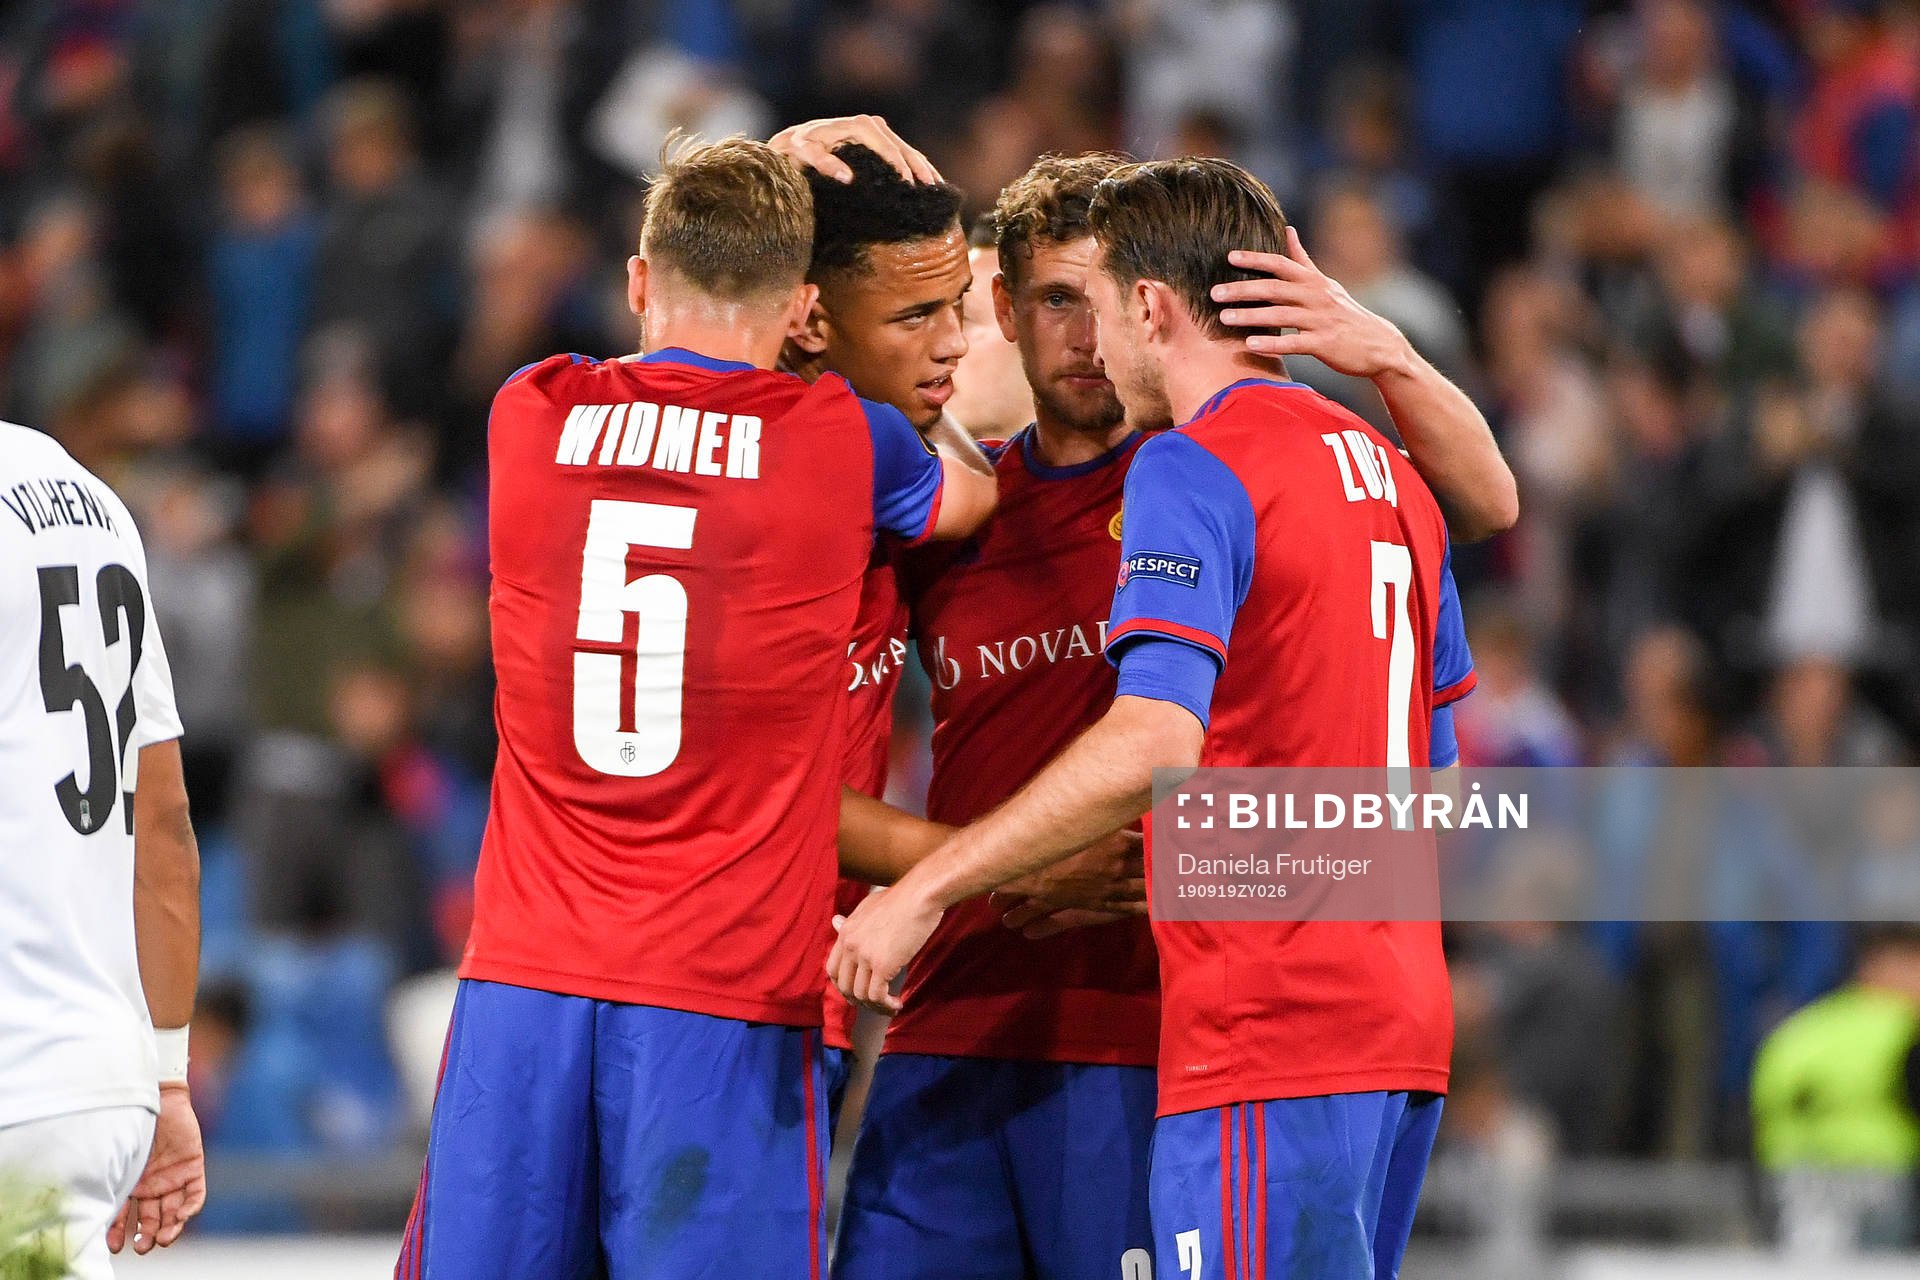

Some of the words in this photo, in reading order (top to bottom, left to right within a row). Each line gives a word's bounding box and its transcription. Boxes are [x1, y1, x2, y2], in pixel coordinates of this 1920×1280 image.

[0, 478, 119, 538] VILHENA
[555, 401, 762, 479] WIDMER
[572, 499, 698, 777] 5
[1129, 558, 1200, 579] RESPECT
[37, 563, 146, 836] 52
[1370, 540, 1415, 831] 7
